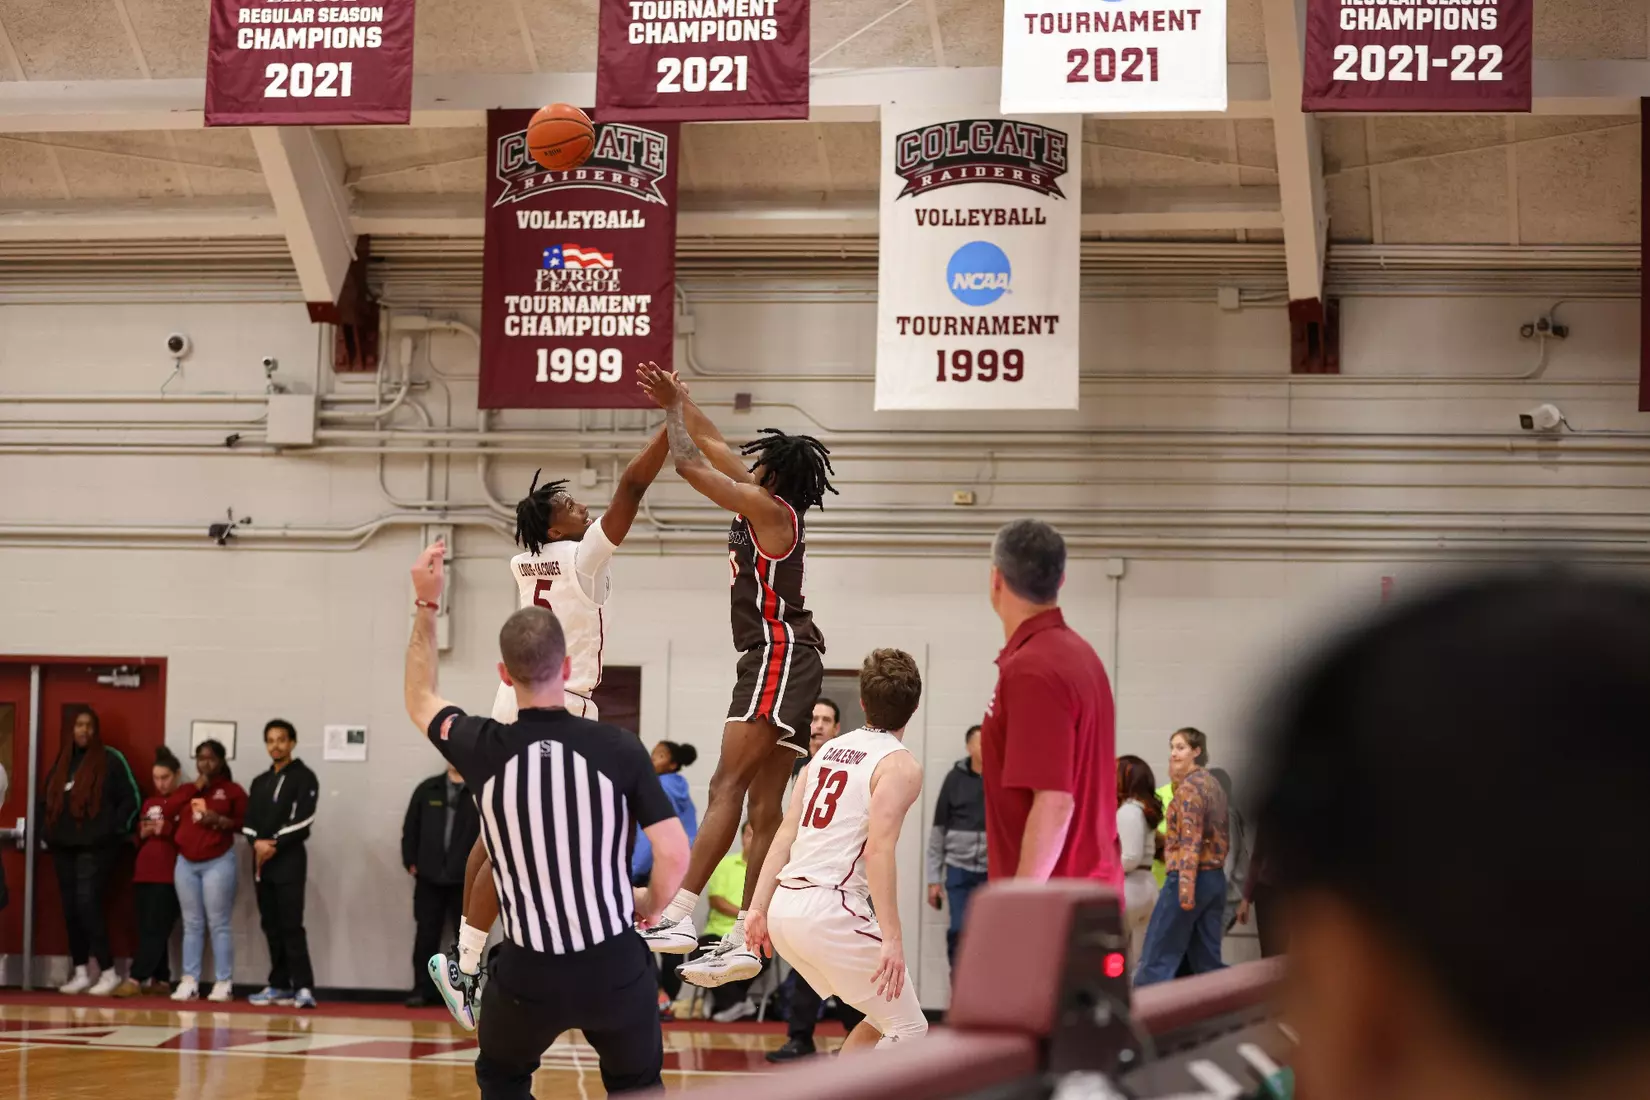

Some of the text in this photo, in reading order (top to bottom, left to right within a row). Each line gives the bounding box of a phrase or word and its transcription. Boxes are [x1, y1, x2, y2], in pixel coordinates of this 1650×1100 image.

[239, 7, 383, 23] REGULAR SEASON
[629, 0, 778, 20] TOURNAMENT
[1340, 8, 1497, 30] CHAMPIONS
[629, 19, 777, 44] CHAMPIONS
[1024, 9, 1201, 34] TOURNAMENT
[237, 27, 382, 49] CHAMPIONS
[657, 56, 748, 92] 2021
[1067, 47, 1158, 82] 2021
[1333, 45, 1503, 81] 2021-22
[264, 62, 352, 97] 2021
[501, 125, 664, 173] CATE
[897, 121, 1066, 170] COLGATE
[524, 170, 640, 189] RAIDERS
[921, 167, 1041, 187] RAIDERS
[516, 210, 645, 229] VOLLEYBALL
[915, 207, 1047, 226] VOLLEYBALL
[535, 279, 621, 292] LEAGUE
[536, 268, 622, 281] PATRIOT
[952, 272, 1009, 290] NCAA
[504, 295, 652, 313] TOURNAMENT
[504, 315, 651, 336] CHAMPIONS
[896, 315, 1060, 335] TOURNAMENT
[536, 348, 622, 383] 1999
[936, 349, 1024, 382] 1999
[802, 766, 849, 829] 13
